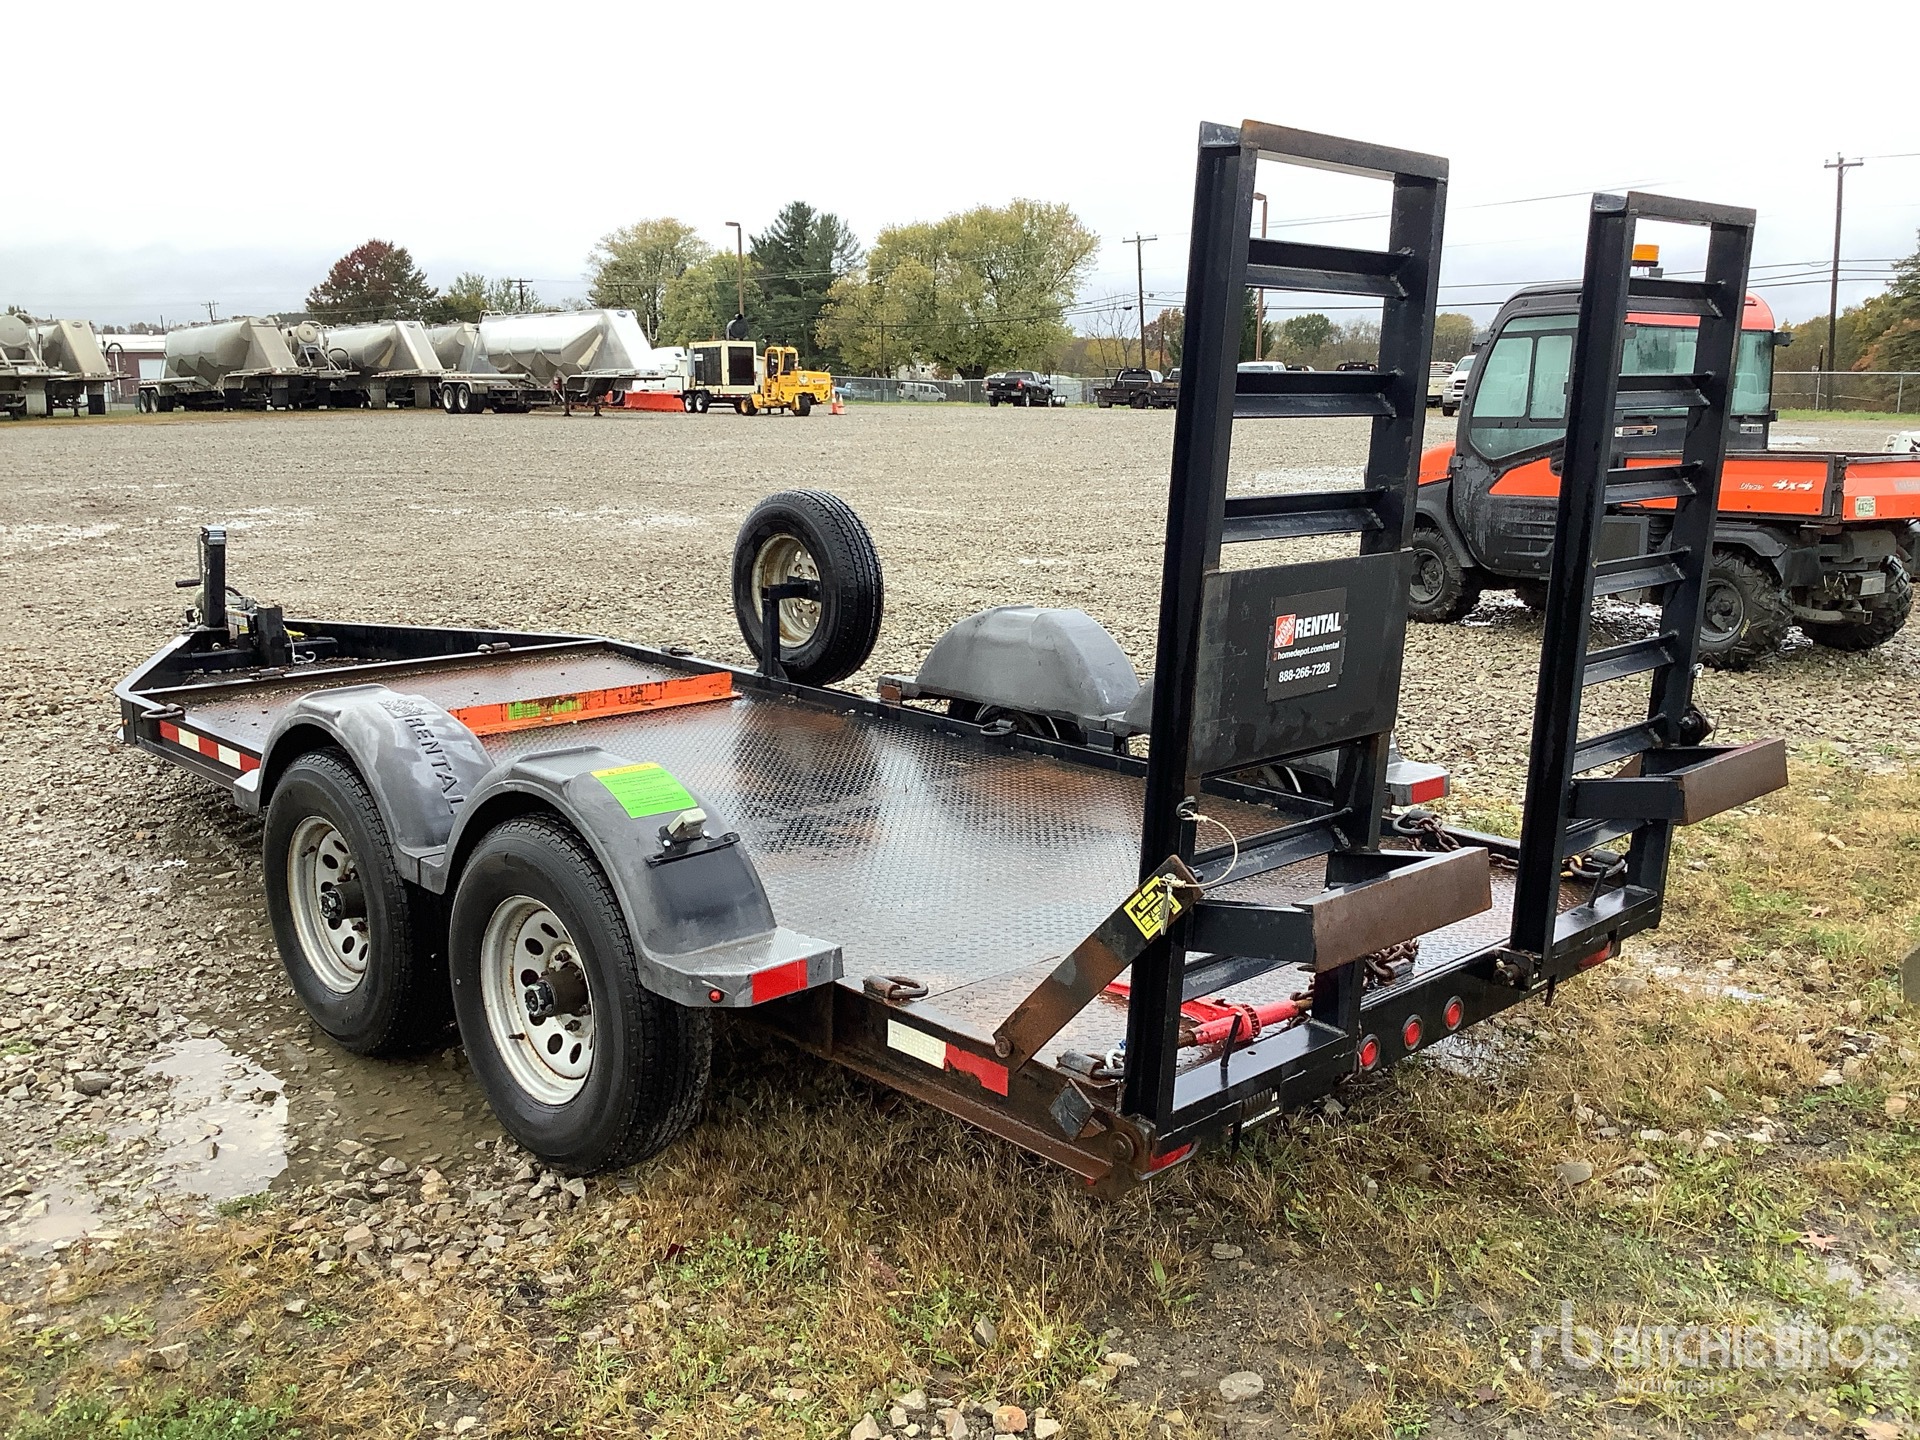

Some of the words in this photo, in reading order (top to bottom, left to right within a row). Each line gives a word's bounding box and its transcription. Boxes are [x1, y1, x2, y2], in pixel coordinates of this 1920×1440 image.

[1294, 612, 1342, 639] RENTAL
[1277, 640, 1340, 660] homedepot.com/rental
[1278, 662, 1331, 683] 888-266-7228
[405, 717, 467, 815] RENTAL
